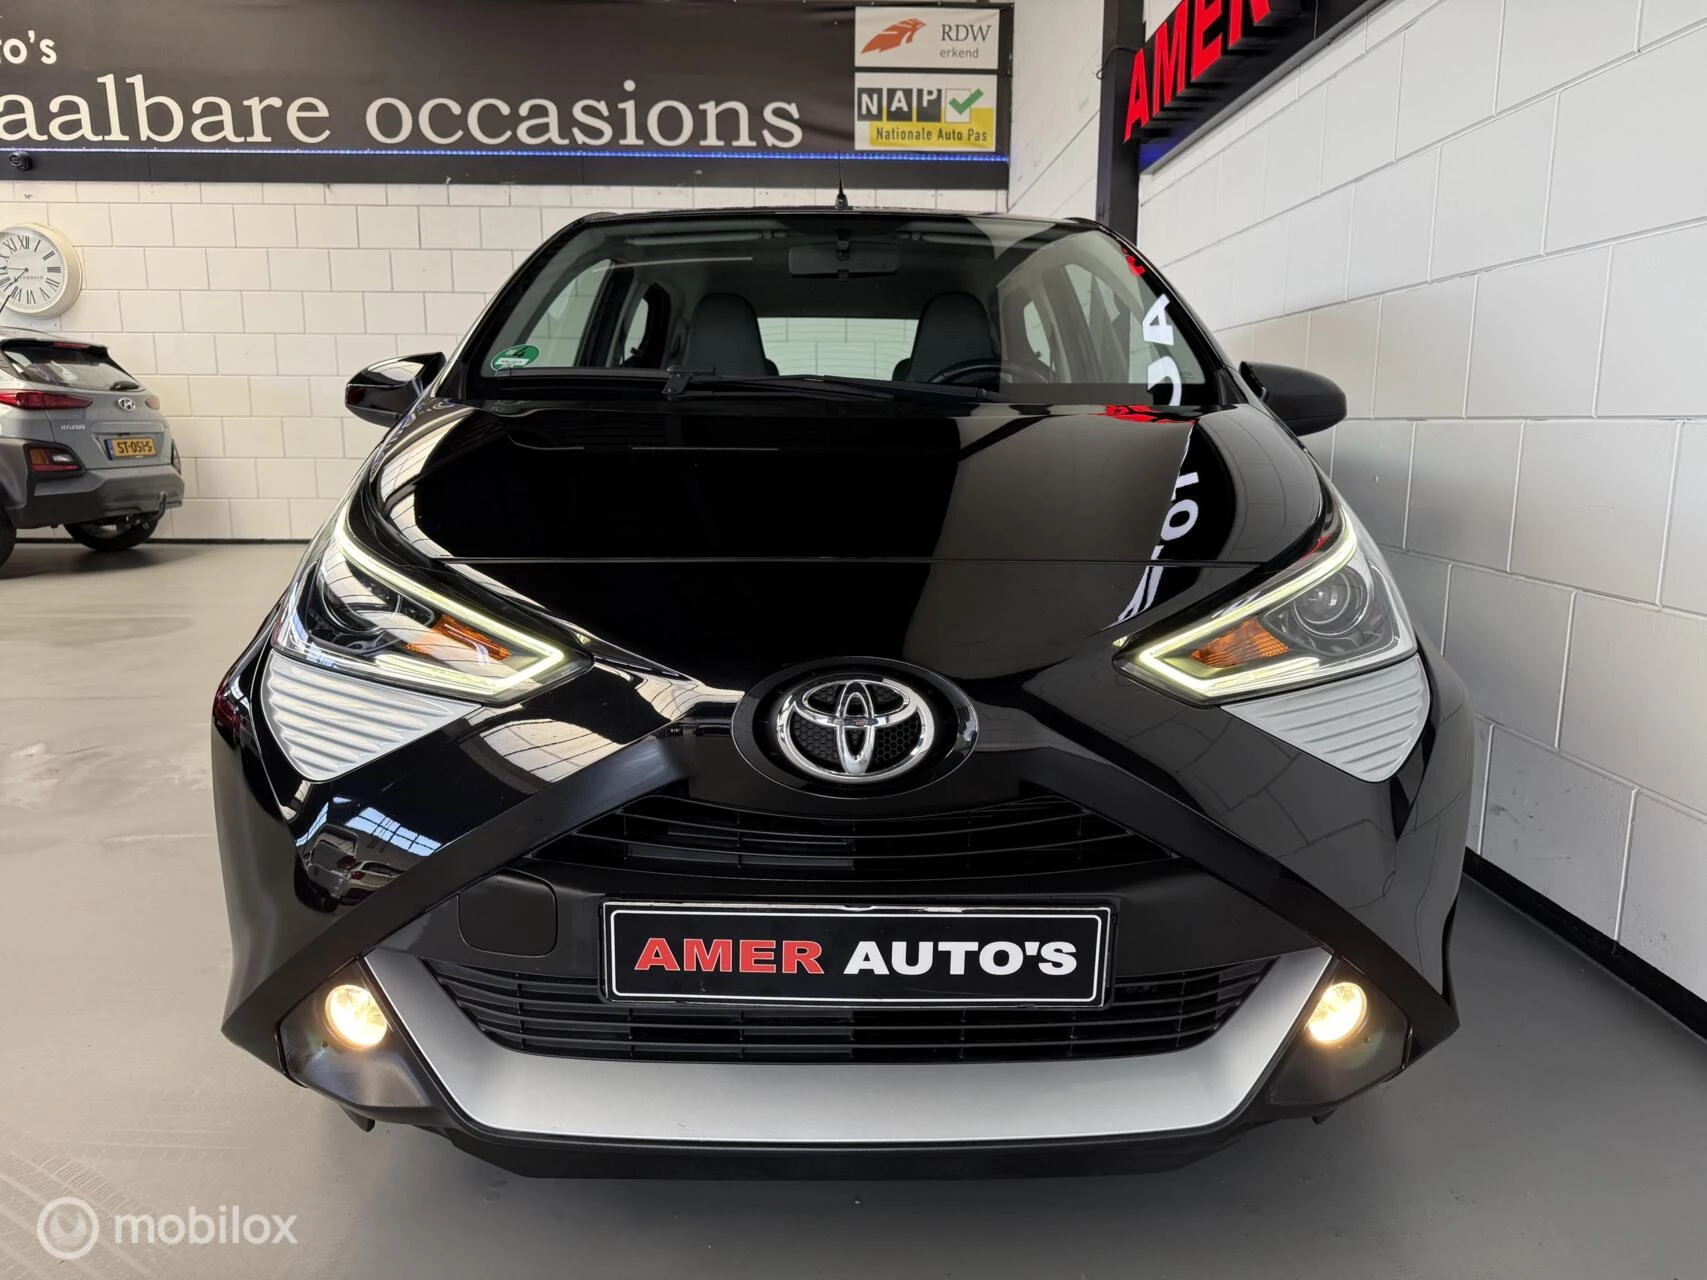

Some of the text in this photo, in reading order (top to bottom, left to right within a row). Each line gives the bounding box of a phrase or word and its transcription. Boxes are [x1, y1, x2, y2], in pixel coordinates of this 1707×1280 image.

[941, 24, 992, 42] RDW
[0, 30, 57, 65] o's
[939, 48, 979, 58] erkend
[365, 79, 803, 148] occasions
[876, 127, 988, 142] Nationale Auto Pas
[634, 937, 1077, 976] AMER AUTO'S
